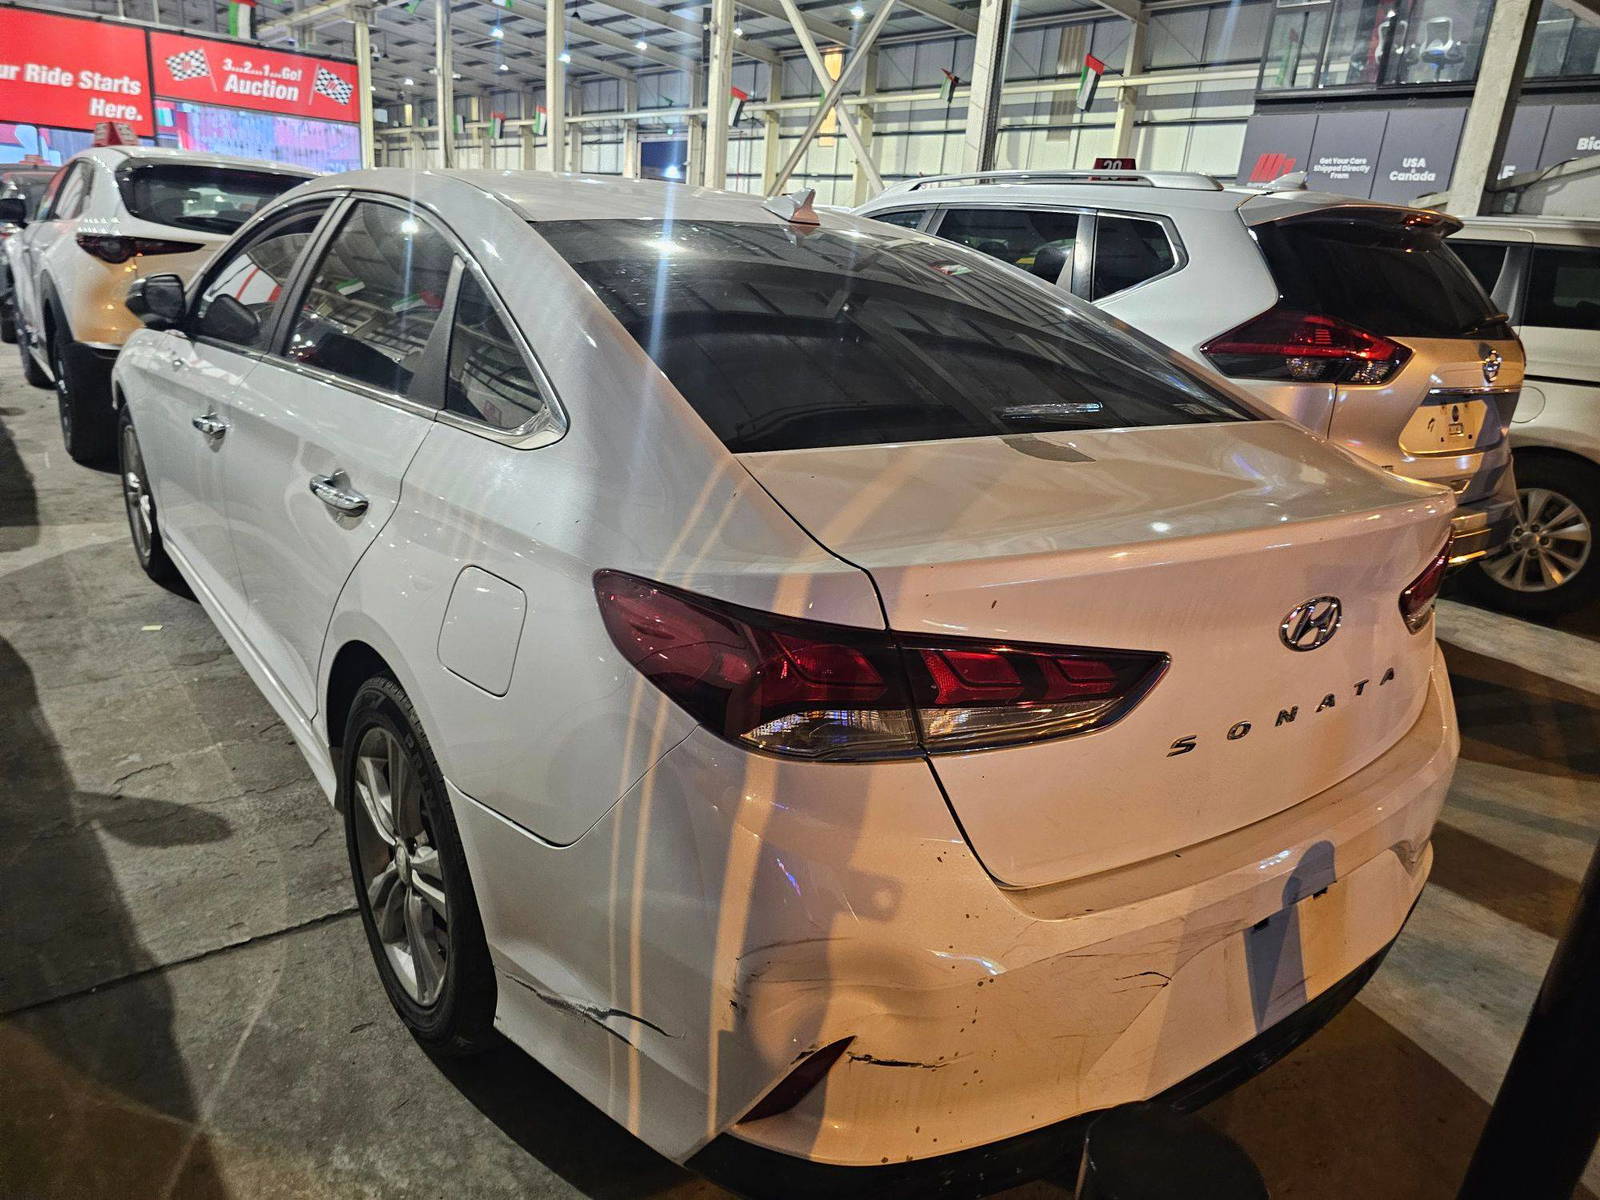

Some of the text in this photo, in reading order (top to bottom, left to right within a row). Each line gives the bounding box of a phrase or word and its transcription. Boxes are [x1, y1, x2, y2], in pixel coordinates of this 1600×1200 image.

[24, 63, 74, 88] Ride
[77, 70, 142, 95] Starts
[224, 73, 299, 102] Auction
[89, 97, 143, 121] Here.
[1319, 157, 1332, 165] Get
[1332, 157, 1350, 165] Your
[1402, 157, 1426, 168] USA
[1313, 164, 1371, 174] Shipped Directly
[1329, 172, 1350, 180] From
[1389, 170, 1436, 181] Canada
[1166, 667, 1395, 758] SONATA
